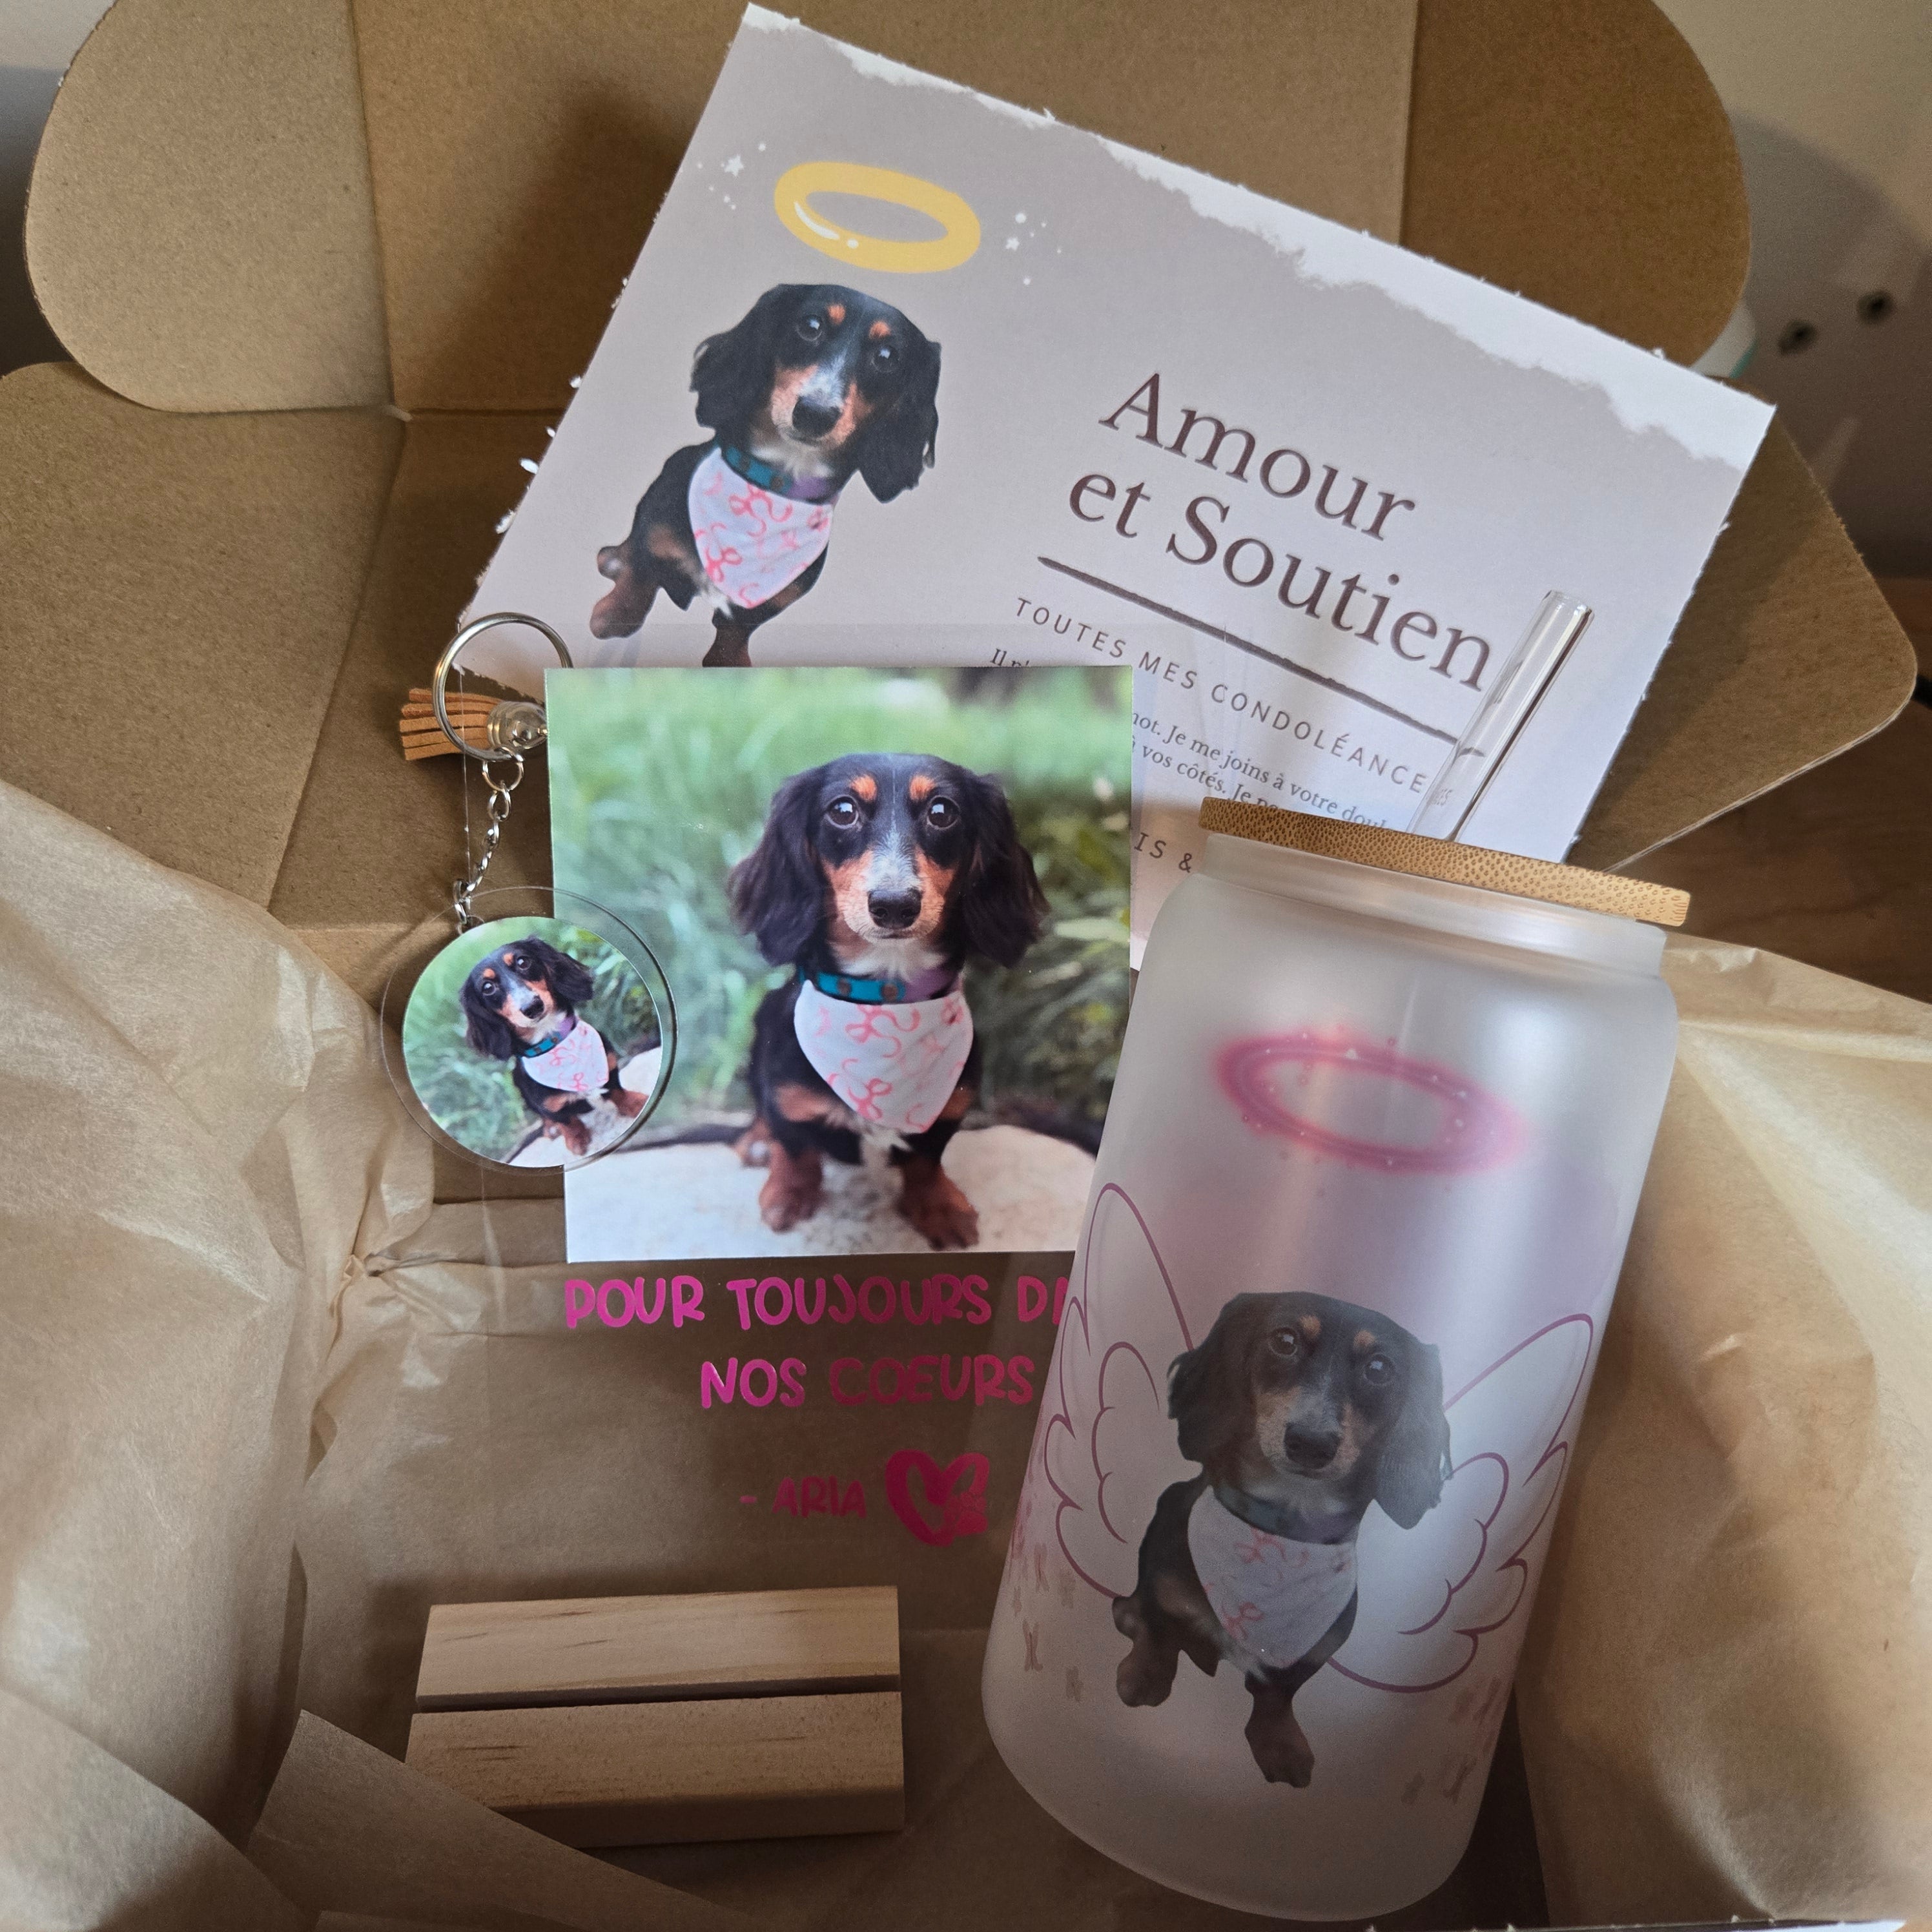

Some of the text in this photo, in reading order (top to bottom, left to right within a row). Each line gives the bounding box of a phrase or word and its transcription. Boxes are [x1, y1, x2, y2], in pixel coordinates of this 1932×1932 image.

[1098, 373, 1415, 540] Amour
[1069, 473, 1491, 692] et Soutien
[1018, 597, 1126, 658] TOUTES
[1138, 652, 1198, 690] MES
[1142, 745, 1173, 768] vos
[1177, 763, 1226, 794] côtés.
[1162, 724, 1186, 745] Je
[1189, 739, 1221, 761] me
[1218, 750, 1270, 784] joins
[1272, 773, 1284, 791] à
[1291, 783, 1338, 814] votre
[1178, 852, 1193, 873] &
[564, 1275, 706, 1329] POUR
[726, 1273, 992, 1330] TOUJOURS
[701, 1353, 1035, 1409] NOS COEURS
[772, 1475, 868, 1519] ARIA
